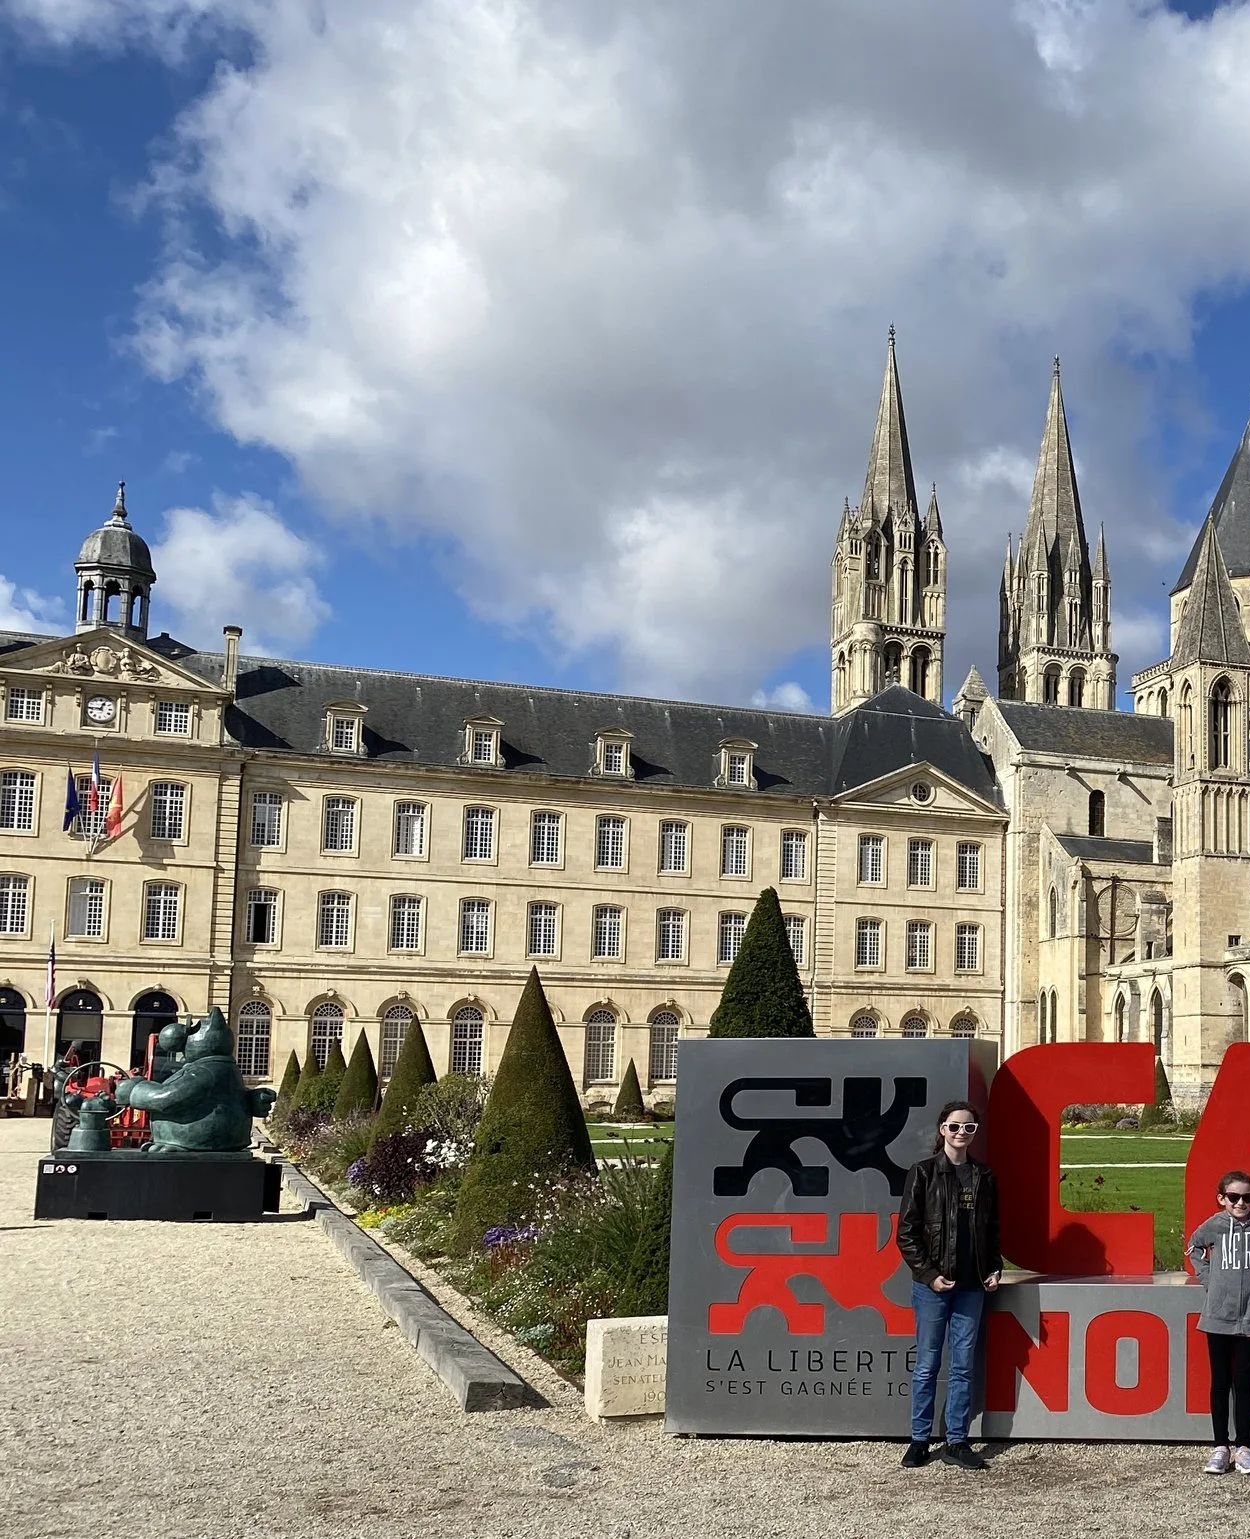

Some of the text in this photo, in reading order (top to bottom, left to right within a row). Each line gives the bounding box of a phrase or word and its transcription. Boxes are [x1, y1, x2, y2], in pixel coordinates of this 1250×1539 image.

[608, 1356, 643, 1369] JEAN
[706, 1345, 917, 1373] LA LIBERTÉ
[705, 1377, 909, 1397] S'EST GAGNÉE IC
